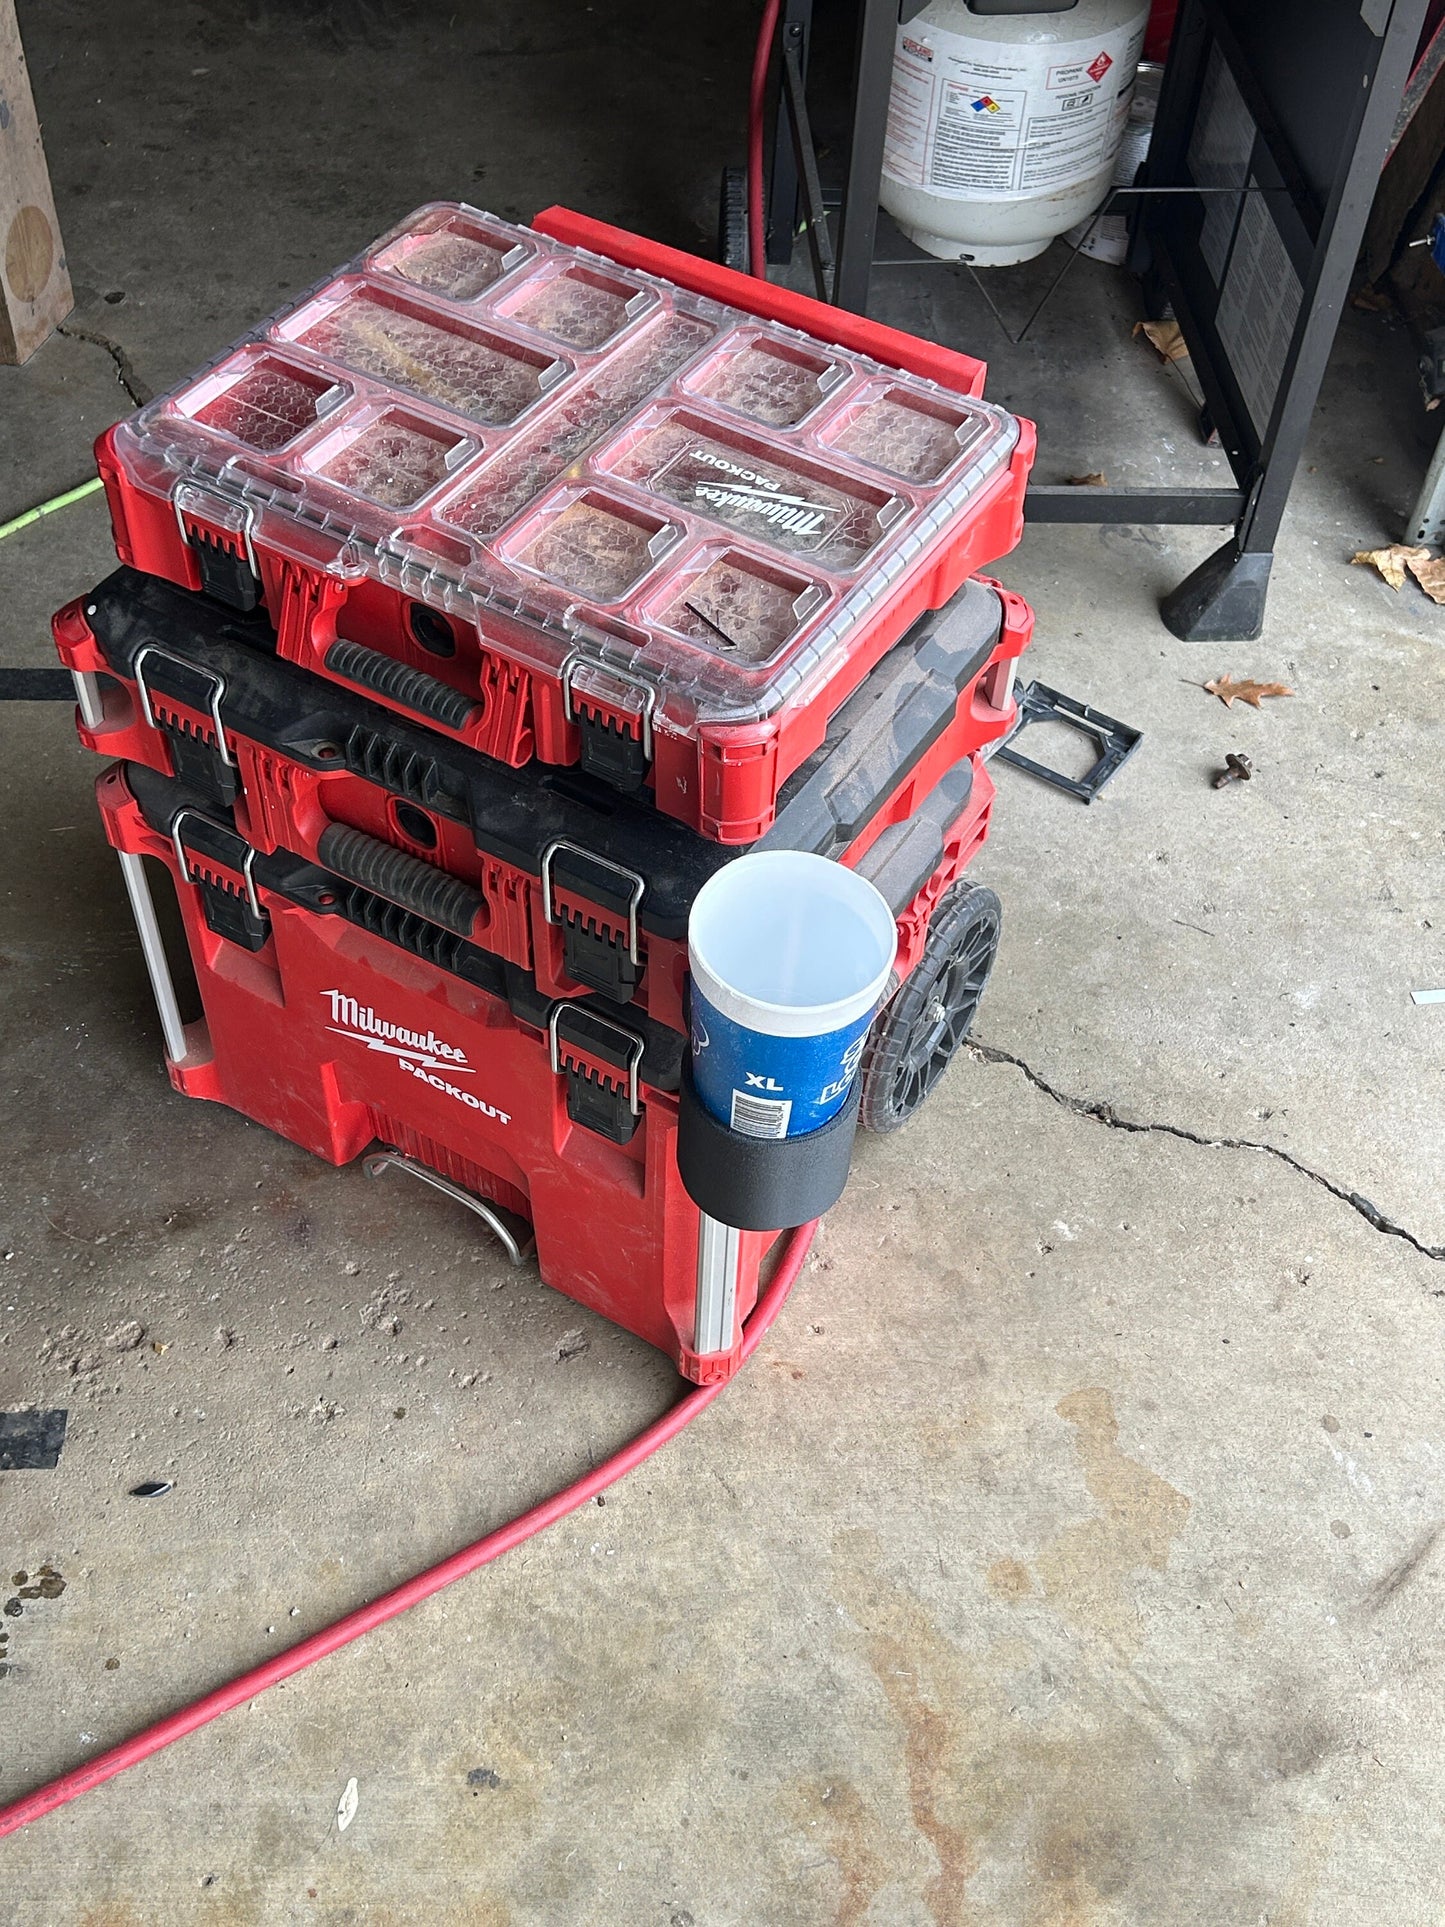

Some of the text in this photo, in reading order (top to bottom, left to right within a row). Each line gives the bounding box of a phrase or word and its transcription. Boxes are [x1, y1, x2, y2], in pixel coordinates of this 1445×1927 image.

[689, 450, 782, 491] PACKOUT
[695, 486, 826, 536] Milwaukee
[319, 989, 468, 1064] Milwaukee
[398, 1057, 512, 1125] PACKOUT
[744, 1071, 784, 1091] XL
